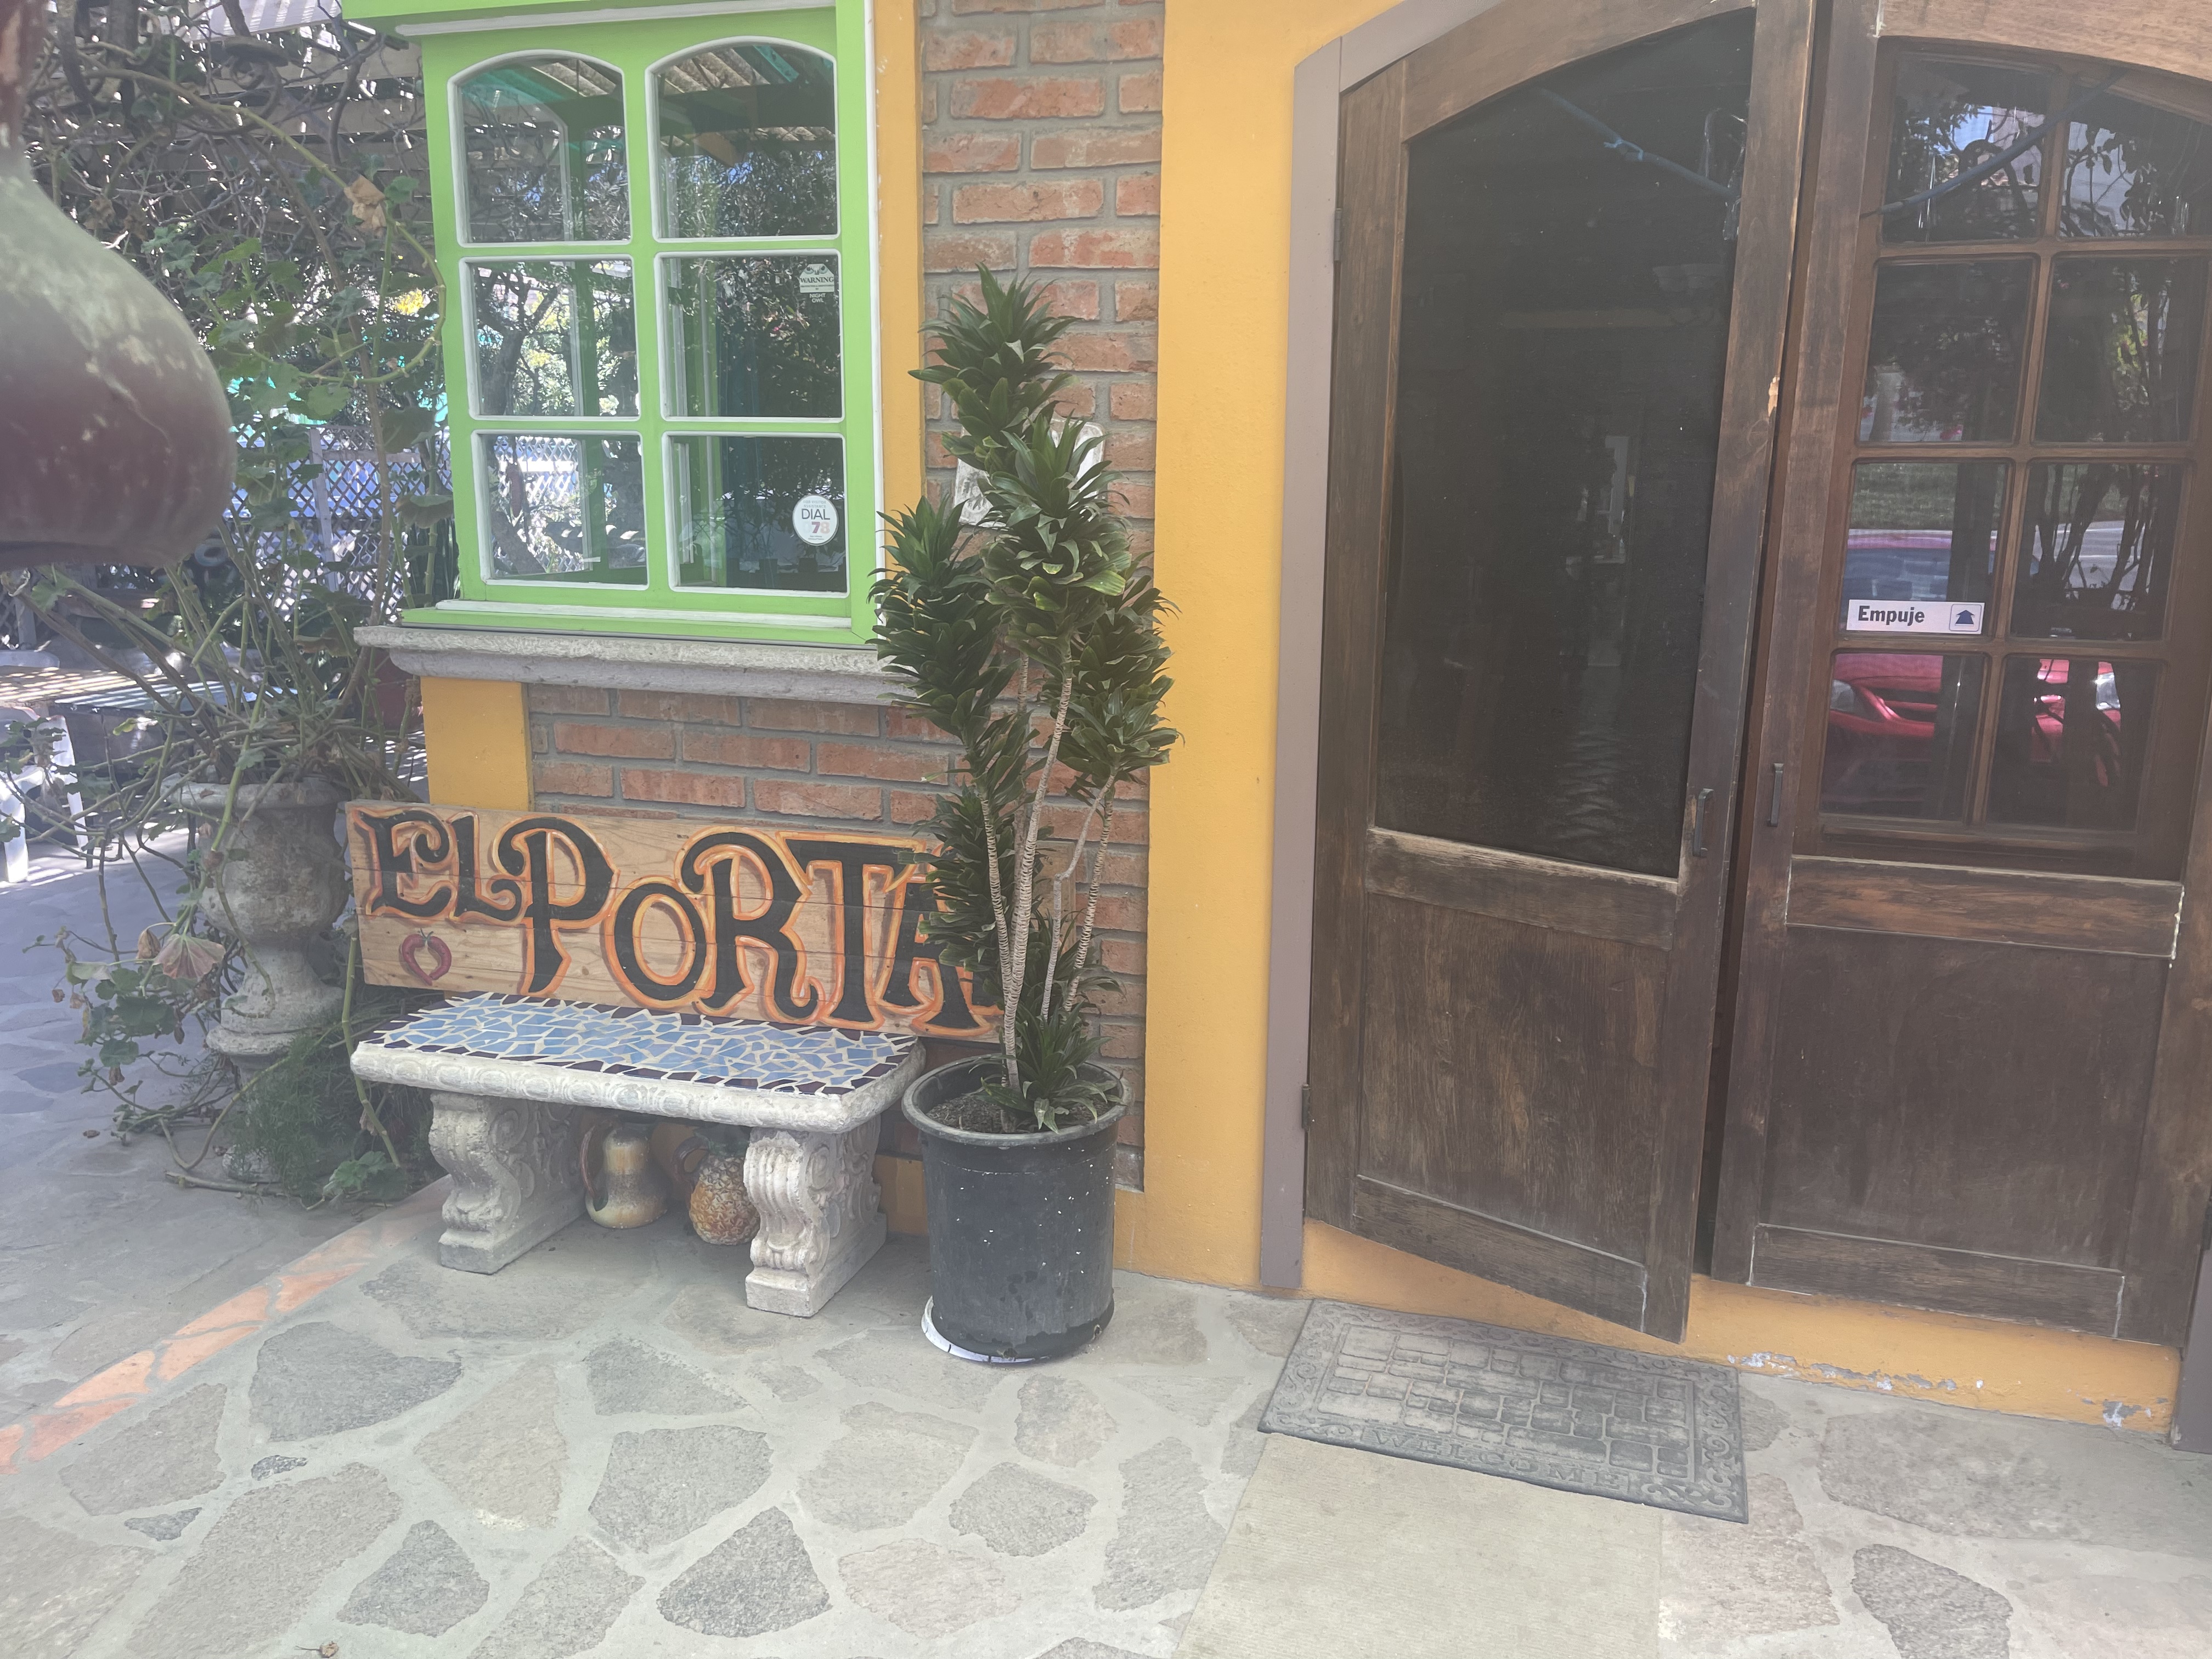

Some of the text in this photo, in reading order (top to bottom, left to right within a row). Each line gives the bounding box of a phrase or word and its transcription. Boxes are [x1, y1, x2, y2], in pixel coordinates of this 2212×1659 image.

[802, 509, 831, 520] DIAL
[1858, 605, 1925, 626] Empuje
[356, 807, 524, 927] EL
[1372, 1427, 1623, 1490] WELCOME
